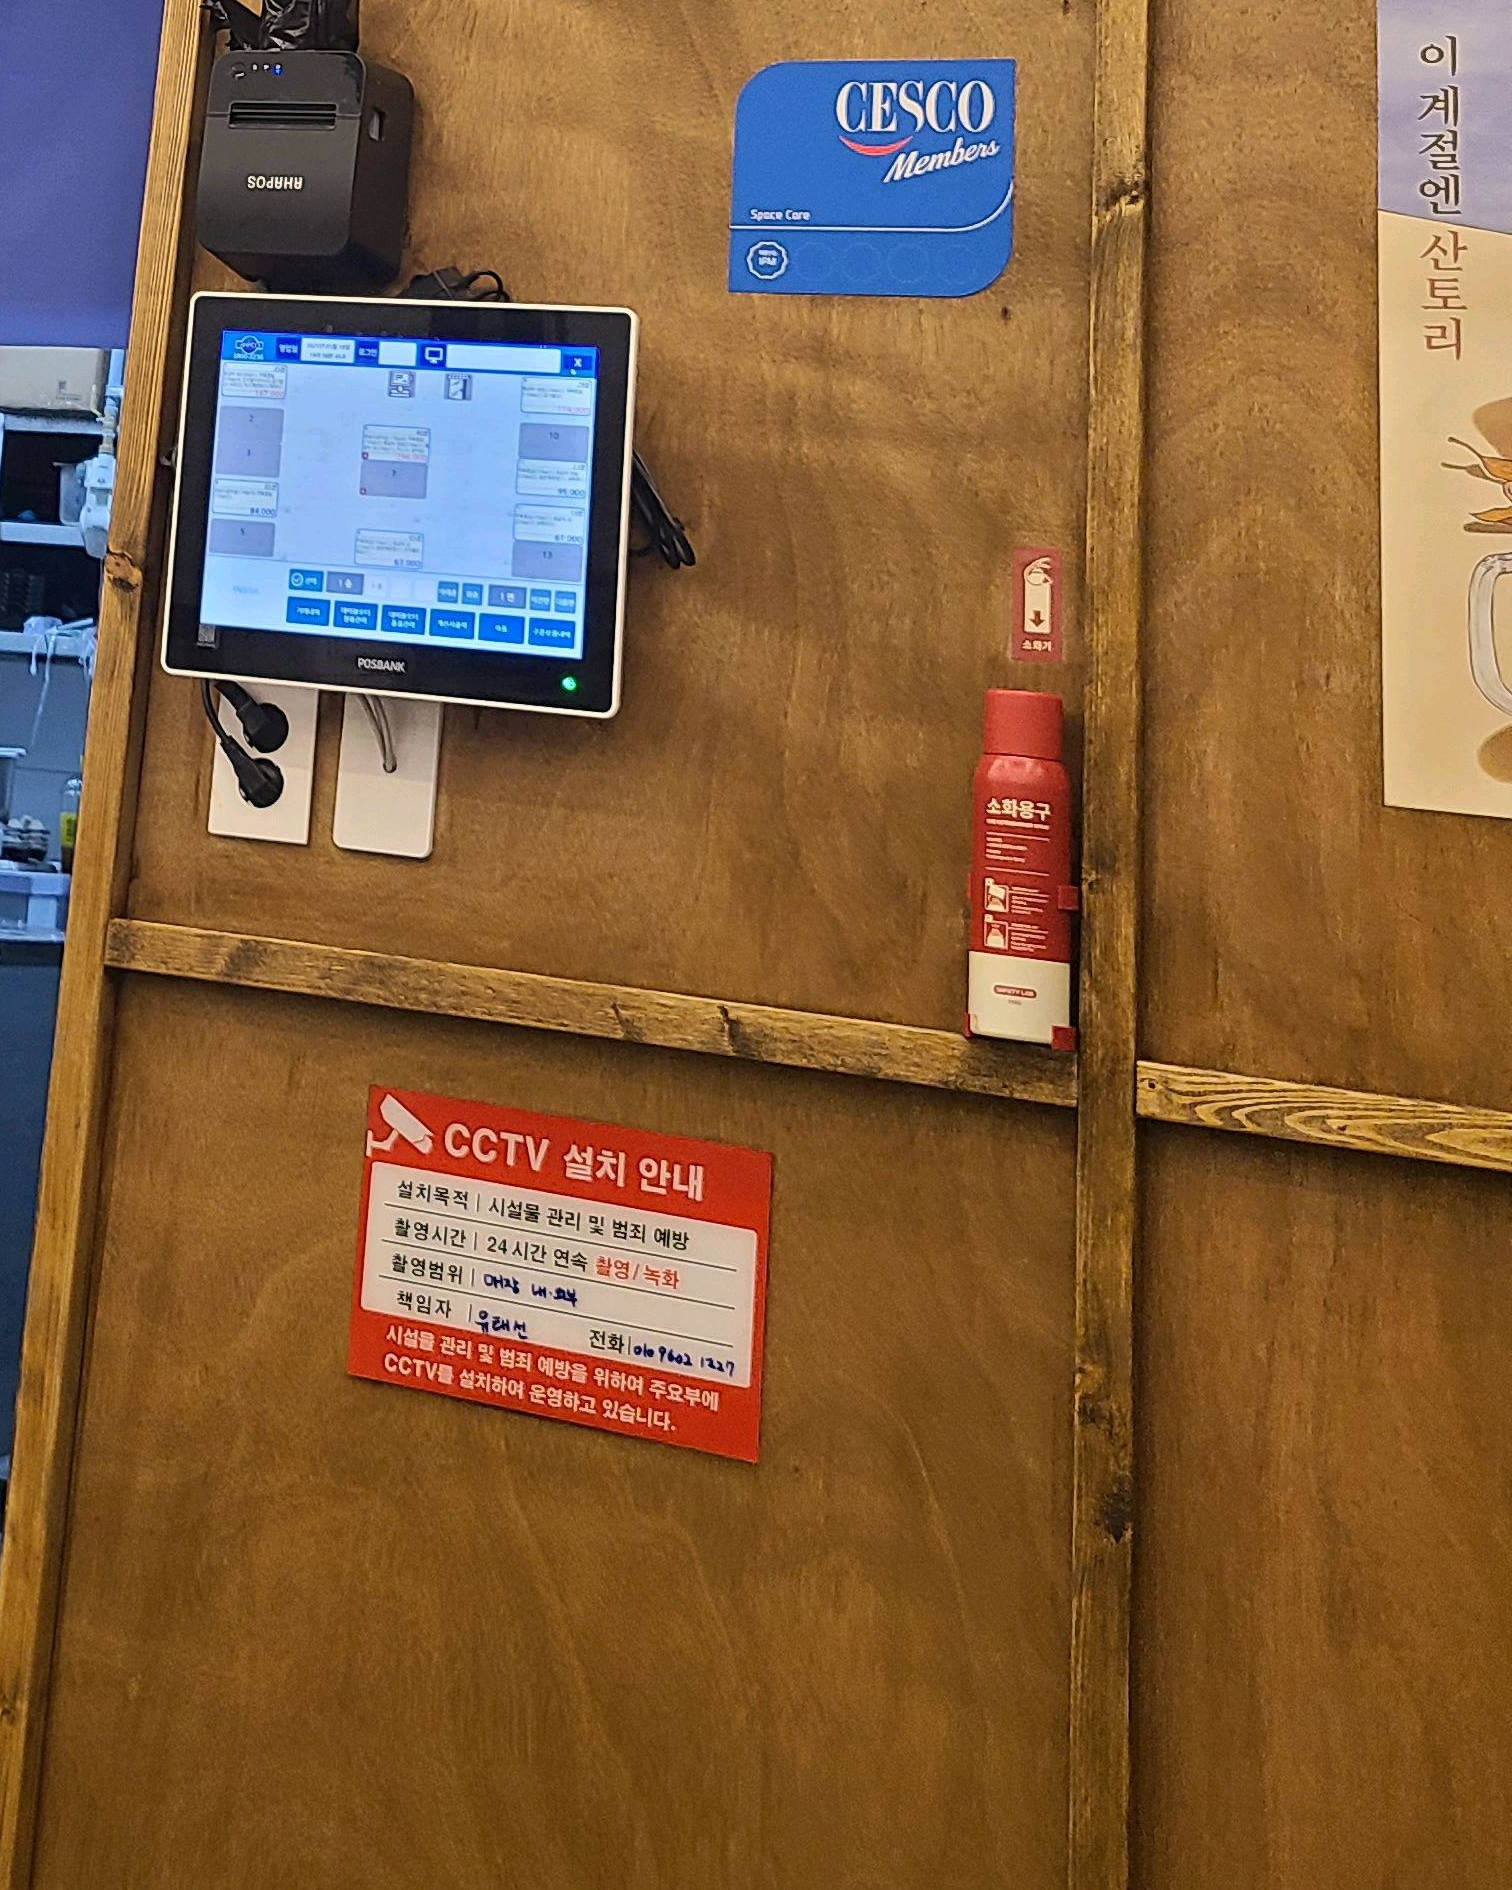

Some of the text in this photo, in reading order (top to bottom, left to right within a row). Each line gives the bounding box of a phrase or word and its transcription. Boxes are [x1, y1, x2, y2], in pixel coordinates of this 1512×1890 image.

[836, 80, 995, 133] CESCO
[883, 137, 1000, 183] Members
[1418, 35, 1469, 361] 이 계절엔 산토리
[357, 657, 406, 673] POSBANK
[986, 797, 1051, 822] 소화용구
[444, 1123, 705, 1202] CCTV 설치 안내
[397, 1180, 689, 1251] 설치목적 시설물 관리 및 범죄 예방
[392, 1253, 463, 1285] 촬영범위
[395, 1217, 467, 1249] 촬영시간
[554, 1248, 587, 1272] 연속
[396, 1290, 452, 1319] 책임자
[590, 1329, 626, 1354] 전화
[385, 1352, 676, 1432] CCTV를 설치하여 운영하고 있습니다.
[440, 1334, 474, 1359] 관리
[477, 1343, 494, 1364] 및
[499, 1347, 532, 1372] 범죄
[537, 1355, 587, 1383] 예방을
[594, 1368, 643, 1396] 위하여
[648, 1381, 719, 1412] 주요부에
